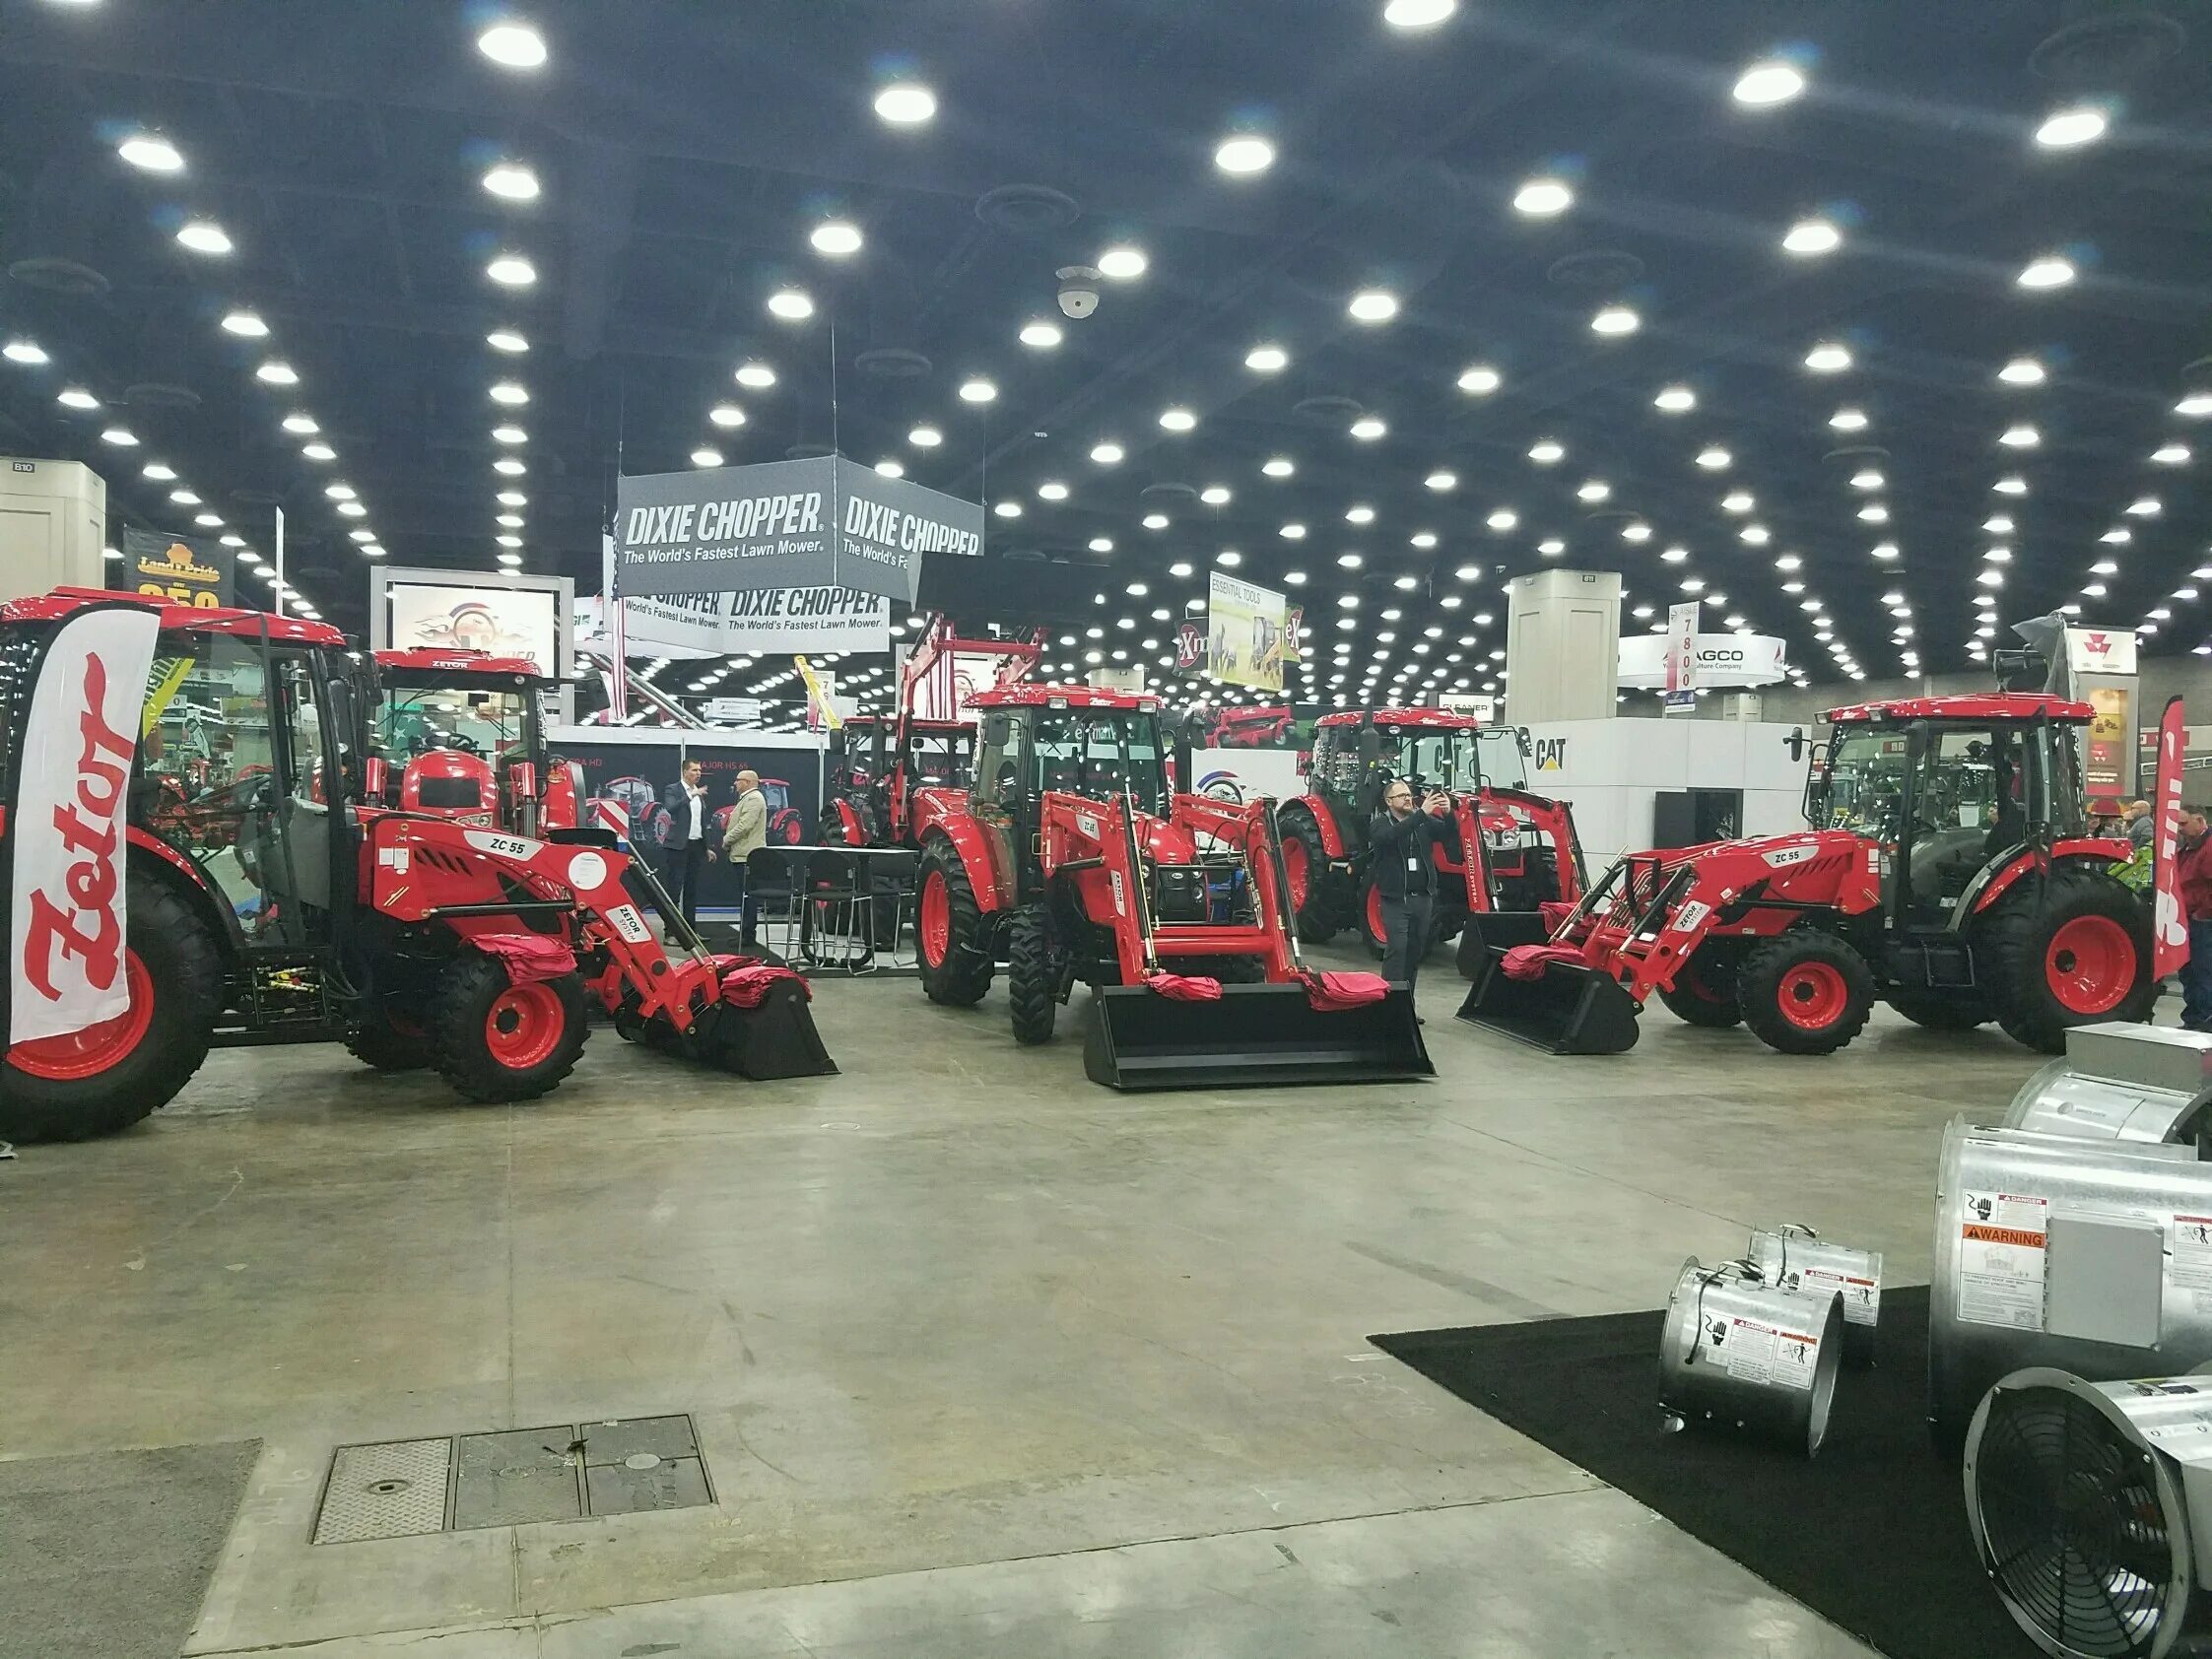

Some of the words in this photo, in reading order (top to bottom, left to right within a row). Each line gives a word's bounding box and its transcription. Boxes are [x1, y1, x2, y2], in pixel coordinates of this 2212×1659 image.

[15, 463, 33, 472] B10
[626, 504, 696, 546] DIXIE
[697, 492, 822, 541] CHOPPER
[844, 496, 901, 547] DIXIE
[624, 550, 645, 564] The
[647, 548, 692, 564] World's
[694, 544, 739, 562] Fastest
[741, 543, 774, 558] Lawn
[842, 538, 861, 556] The
[862, 544, 897, 566] World's
[730, 589, 785, 617] DIXIE
[787, 587, 881, 617] CHOPPER
[1212, 577, 1241, 599] ESSENTIAL
[1242, 588, 1261, 605] TOOLS
[626, 599, 652, 616] World's
[653, 607, 679, 622] Fastest
[679, 613, 698, 626] Lawn
[728, 620, 745, 630] The
[747, 620, 781, 630] World's
[783, 620, 818, 630] Fastest
[820, 619, 845, 630] Lawn
[432, 660, 469, 669] ZETOR
[1714, 662, 1742, 671] Company
[701, 761, 723, 769] AJOR
[1434, 744, 1462, 773] CT
[1535, 738, 1567, 770] CAT
[24, 650, 136, 1002] Zetor
[490, 838, 508, 851] ZC
[508, 841, 526, 854] 55
[1775, 853, 1786, 863] ZC
[1788, 850, 1799, 860] 55
[619, 906, 641, 934] ZETOR
[1679, 904, 1698, 928] ZETOR
[619, 918, 637, 941] SYSTEM
[2011, 1196, 2043, 1205] DANGER
[1980, 1228, 2043, 1246] WARNING
